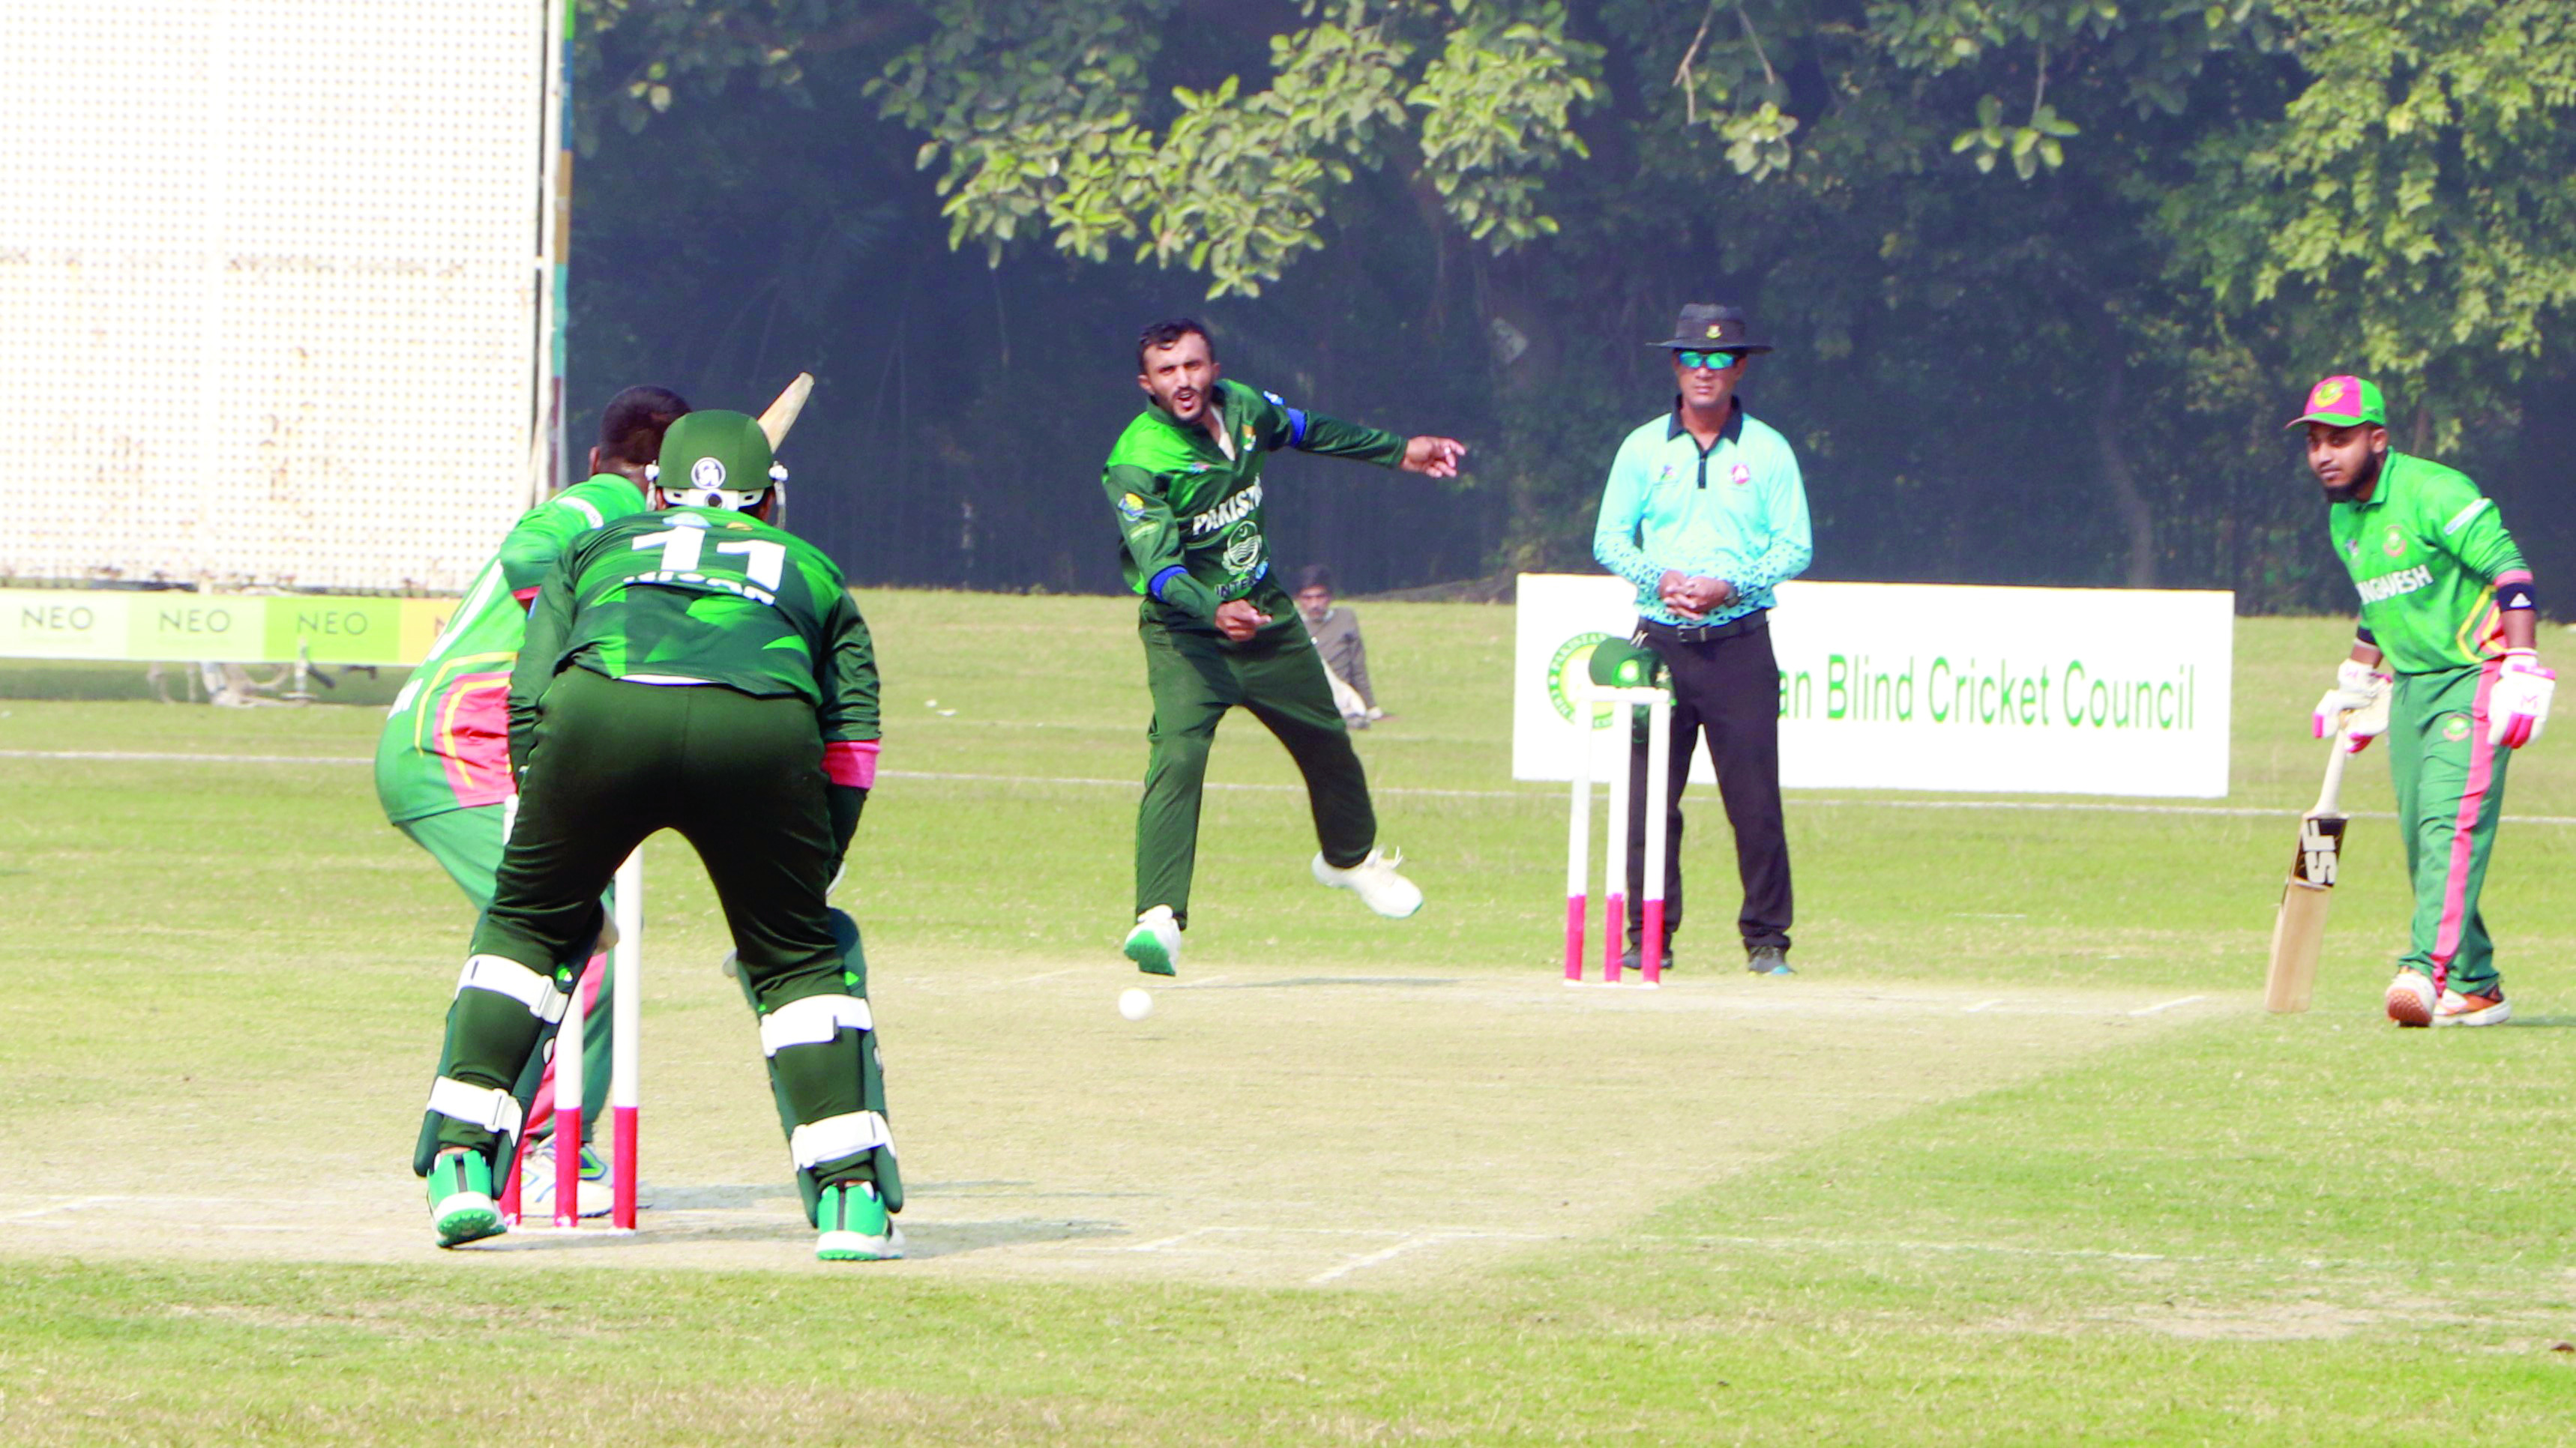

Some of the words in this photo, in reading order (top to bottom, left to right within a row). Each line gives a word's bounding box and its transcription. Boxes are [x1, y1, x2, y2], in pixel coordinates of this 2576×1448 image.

[631, 525, 786, 592] 11
[21, 606, 94, 630] NEO
[159, 609, 231, 633] NEO
[297, 611, 368, 636] NEO
[1827, 654, 1914, 721] Blind
[1929, 656, 2050, 725] Cricket
[2063, 660, 2194, 729] Council
[2302, 818, 2338, 884] SF
